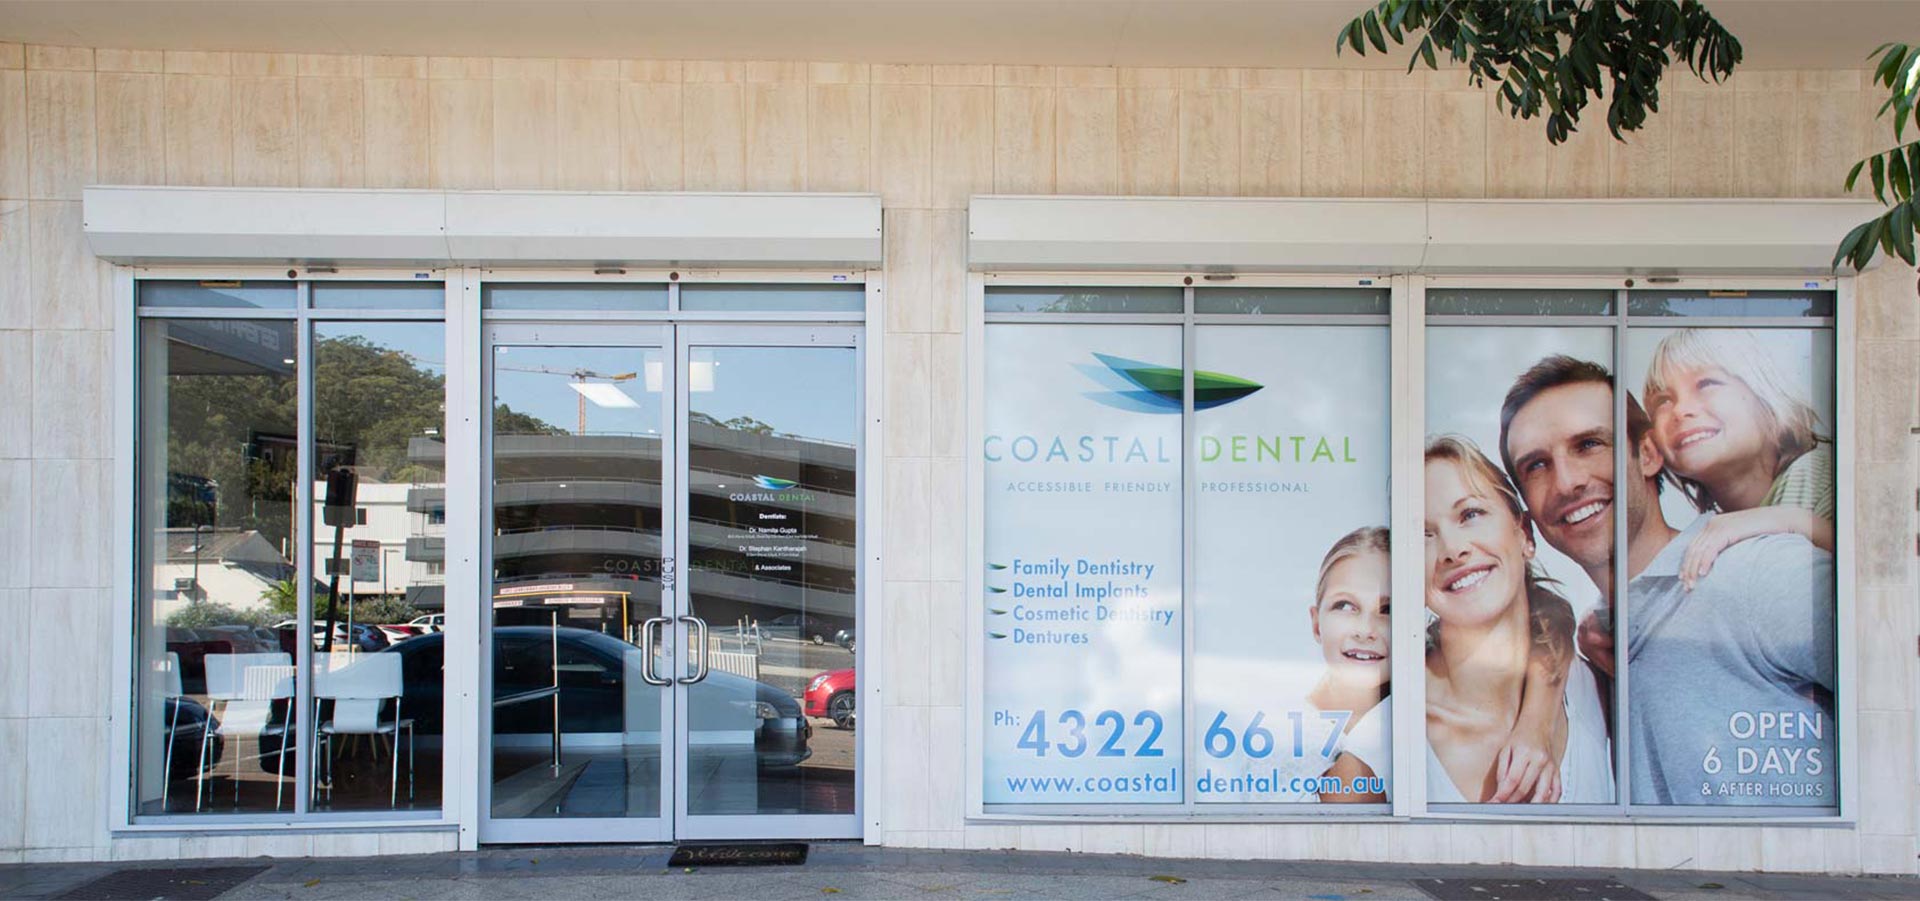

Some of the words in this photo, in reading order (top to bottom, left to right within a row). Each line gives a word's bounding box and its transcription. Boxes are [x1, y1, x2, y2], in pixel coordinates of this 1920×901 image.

[983, 435, 1170, 462] COASTAL
[1201, 435, 1357, 462] DENTAL
[1007, 481, 1092, 492] ACCESSIBLE
[1104, 481, 1171, 492] FRIENDLY
[1201, 481, 1310, 492] PROFESSIONAL
[729, 493, 775, 501] COASTAL
[778, 494, 816, 502] DENTAL
[779, 527, 798, 536] Gupta
[603, 559, 662, 571] COAST
[662, 556, 674, 592] PUSH
[1013, 558, 1070, 579] Family
[1077, 559, 1154, 579] Dentistry
[1013, 581, 1068, 598] Dental
[1075, 581, 1148, 602] Implants
[1013, 605, 1090, 621] Cosmetic
[1097, 605, 1174, 626] Dentistry
[1013, 628, 1088, 644] Dentures
[994, 710, 1020, 726] Ph:
[1017, 710, 1164, 758] 4322
[1204, 710, 1353, 759] 6617
[1729, 711, 1822, 739] OPEN
[1703, 747, 1722, 774] 6
[1737, 747, 1823, 775] DAYS
[1007, 767, 1177, 792] www.coastal
[1197, 768, 1384, 793] dental.com.au
[1701, 782, 1712, 795] &
[1718, 782, 1763, 796] AFTER
[1769, 783, 1823, 796] HOURS
